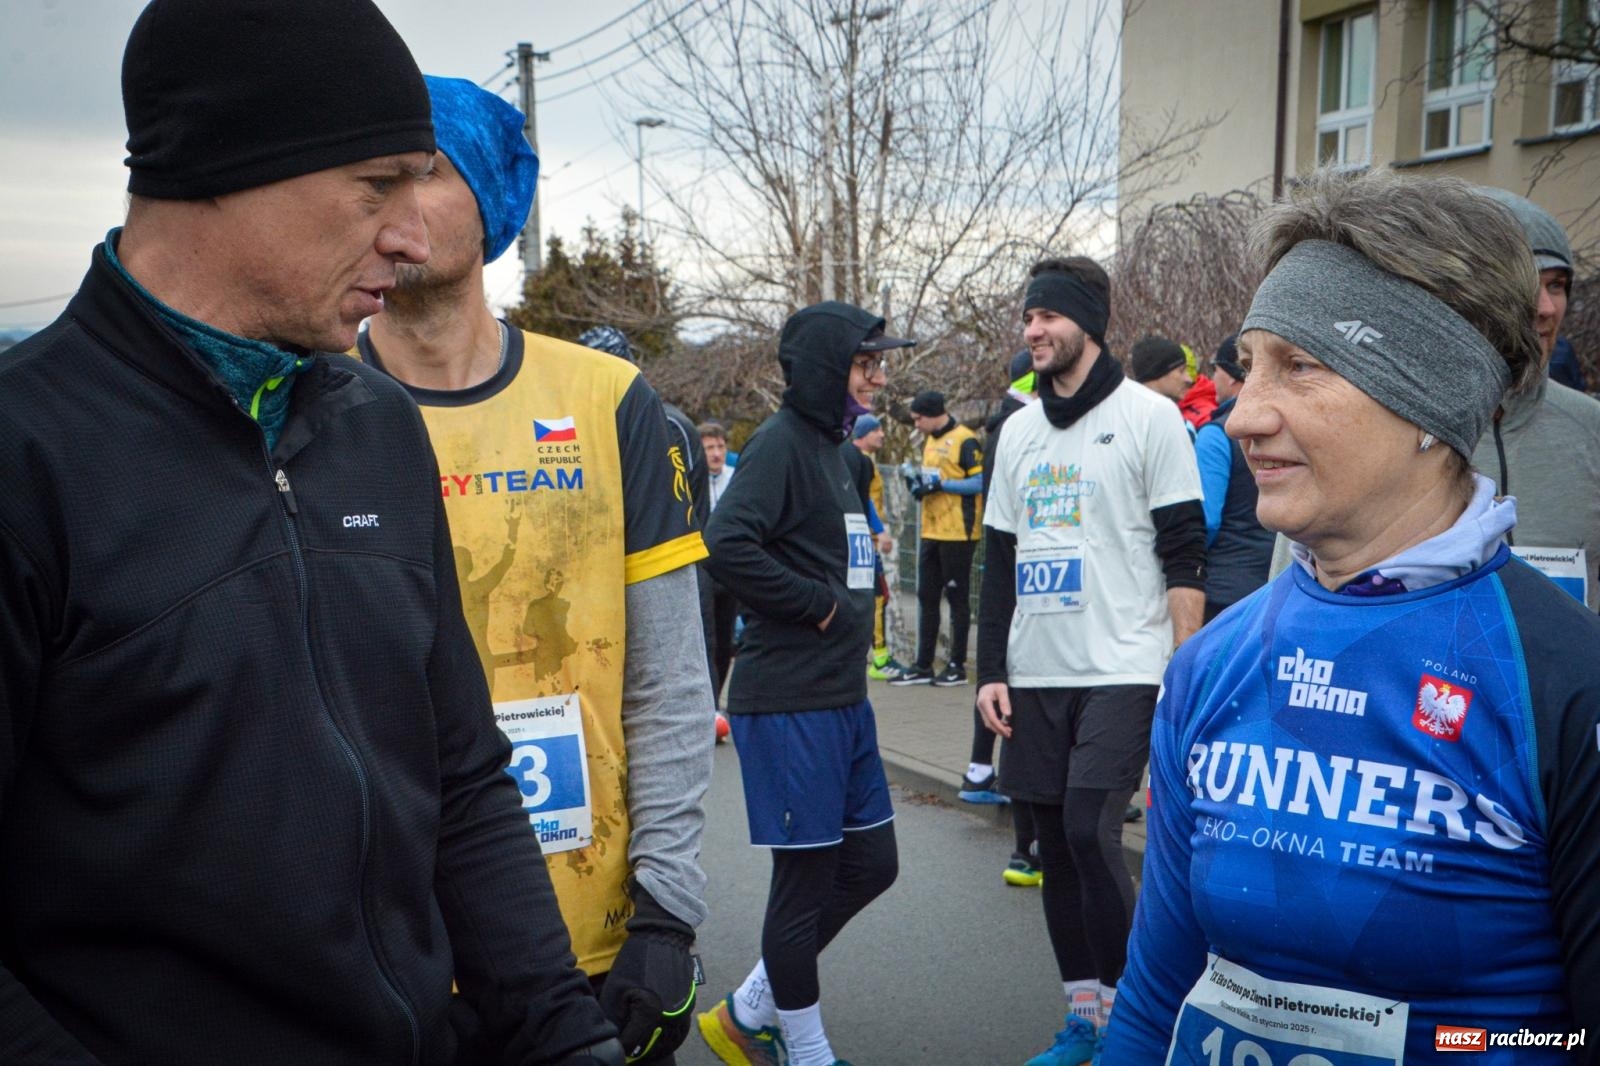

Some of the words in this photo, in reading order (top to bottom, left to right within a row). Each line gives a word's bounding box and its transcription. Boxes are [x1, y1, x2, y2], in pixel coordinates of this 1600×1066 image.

[1333, 320, 1383, 345] 4F
[537, 444, 581, 454] CZECH
[539, 456, 582, 465] REPUBLIC
[483, 468, 584, 493] TEAM
[1023, 561, 1069, 592] 207
[1186, 741, 1526, 850] RUNNERS
[1339, 841, 1435, 873] TEAM
[1216, 973, 1228, 988] Eko
[1226, 978, 1243, 995] Cross
[1241, 988, 1251, 1000] po
[1250, 989, 1272, 1008] Ziemi
[1274, 997, 1381, 1027] Pietrowickiej
[1259, 1018, 1289, 1030] stycznia
[1290, 1023, 1310, 1033] 2025
